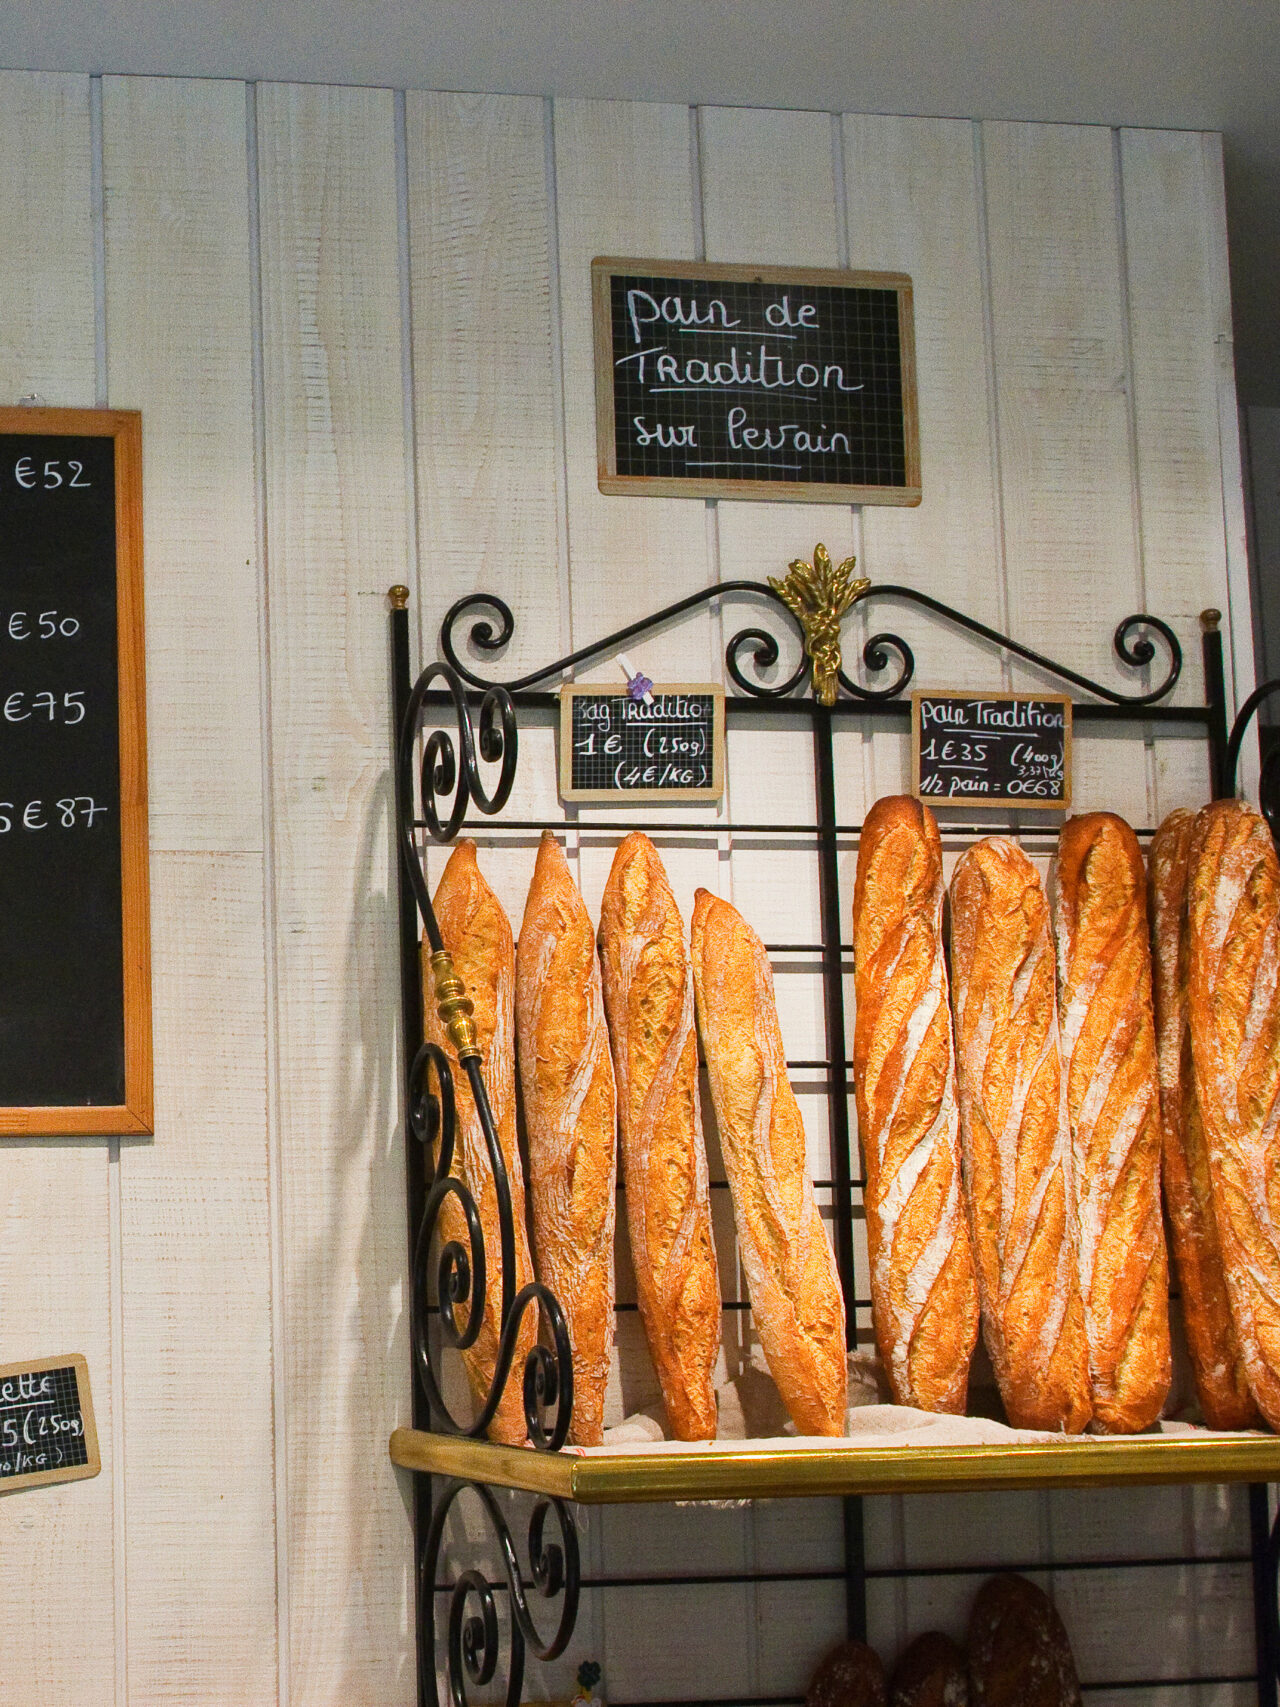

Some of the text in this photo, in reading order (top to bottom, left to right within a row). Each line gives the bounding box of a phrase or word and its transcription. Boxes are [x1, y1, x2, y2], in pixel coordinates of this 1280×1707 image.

[765, 295, 819, 329] de
[633, 407, 851, 455] sur levain
[967, 700, 1068, 728] Tradition
[574, 728, 706, 758] 1€ (250g)
[920, 738, 1065, 770] 1€35 (400g)
[919, 773, 943, 794] 1/2
[949, 775, 989, 798] pain
[1006, 779, 1061, 796] 0€68
[23, 1409, 85, 1445] (250g)
